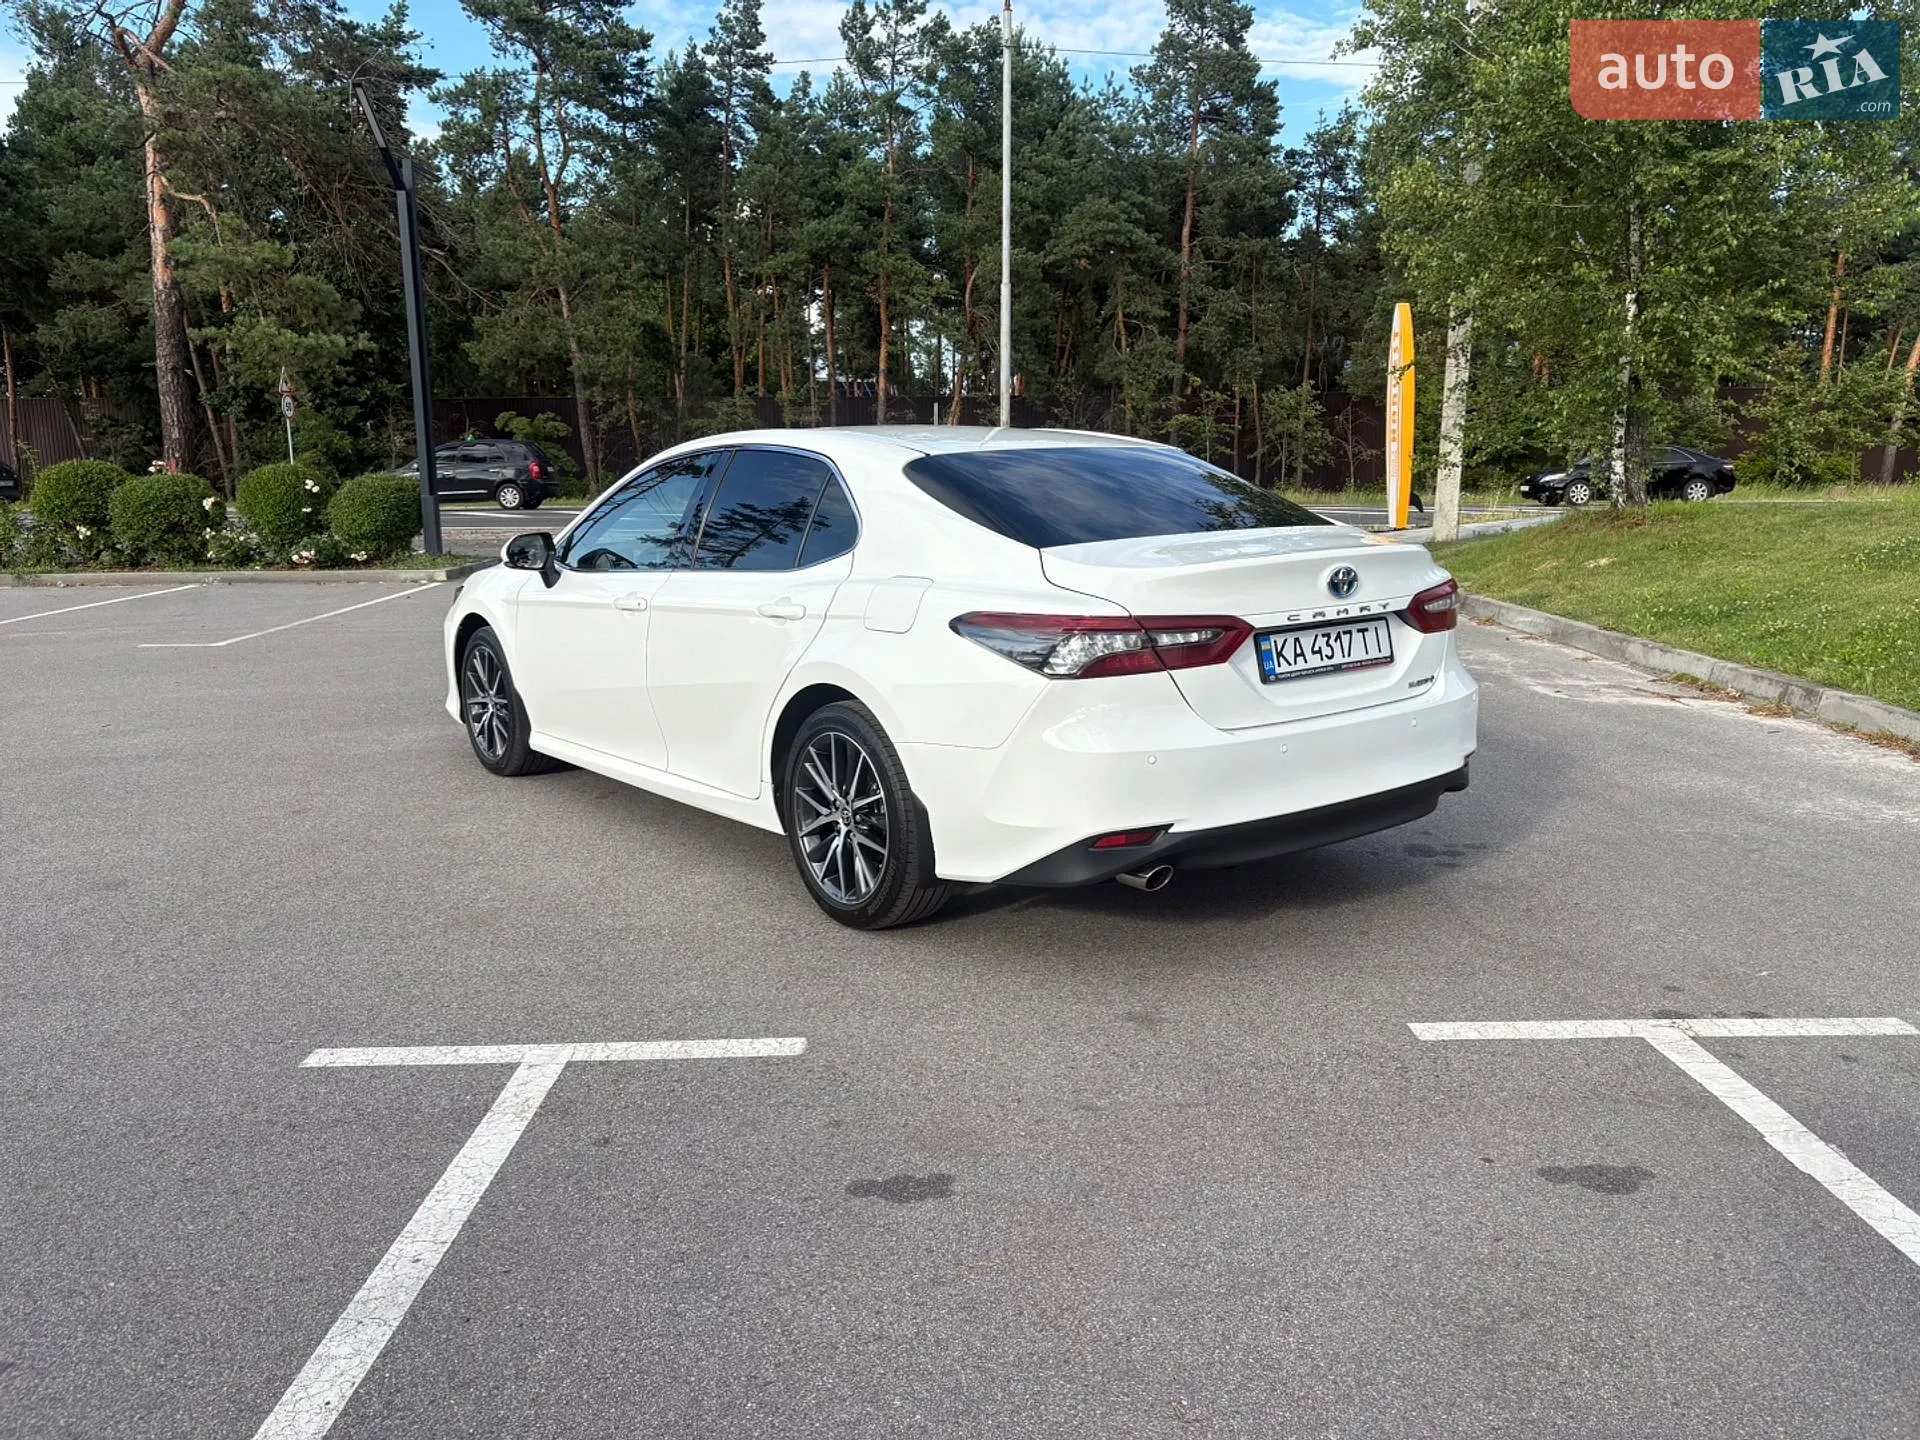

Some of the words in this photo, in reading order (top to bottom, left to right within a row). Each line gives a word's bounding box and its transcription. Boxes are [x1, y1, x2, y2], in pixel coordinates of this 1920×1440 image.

[1287, 602, 1390, 622] CAMRY
[1274, 636, 1308, 668] KA
[1311, 629, 1353, 661] 4317
[1356, 626, 1382, 655] TI
